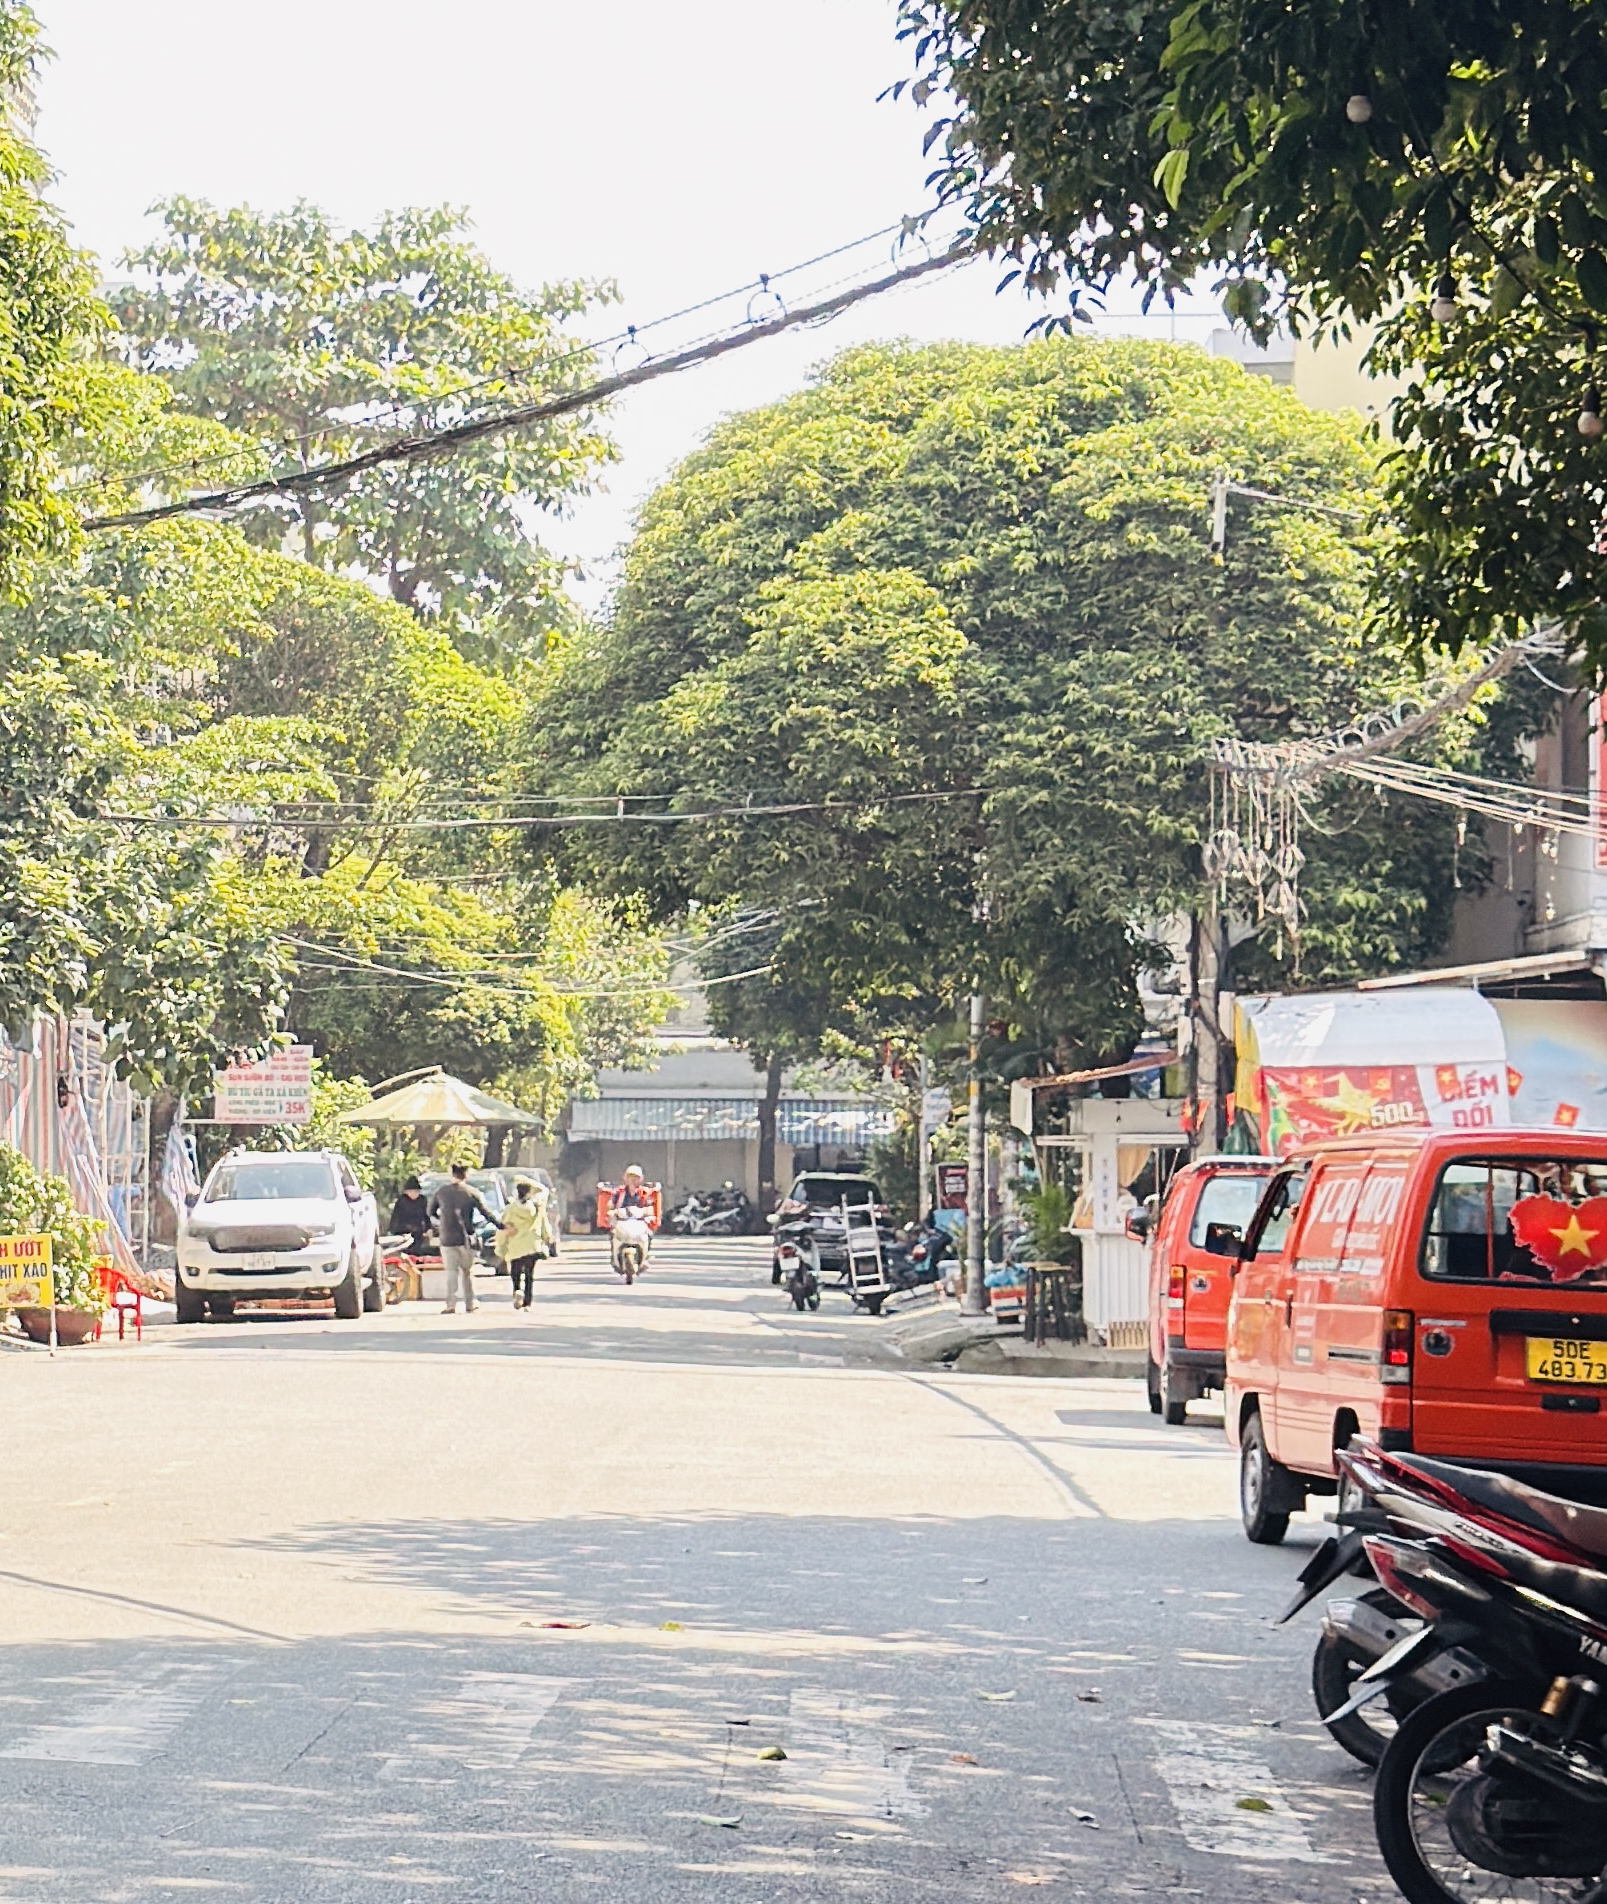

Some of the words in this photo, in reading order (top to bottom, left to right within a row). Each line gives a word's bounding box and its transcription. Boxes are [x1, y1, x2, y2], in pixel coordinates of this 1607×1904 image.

[1370, 1101, 1413, 1127] 500
[14, 1239, 44, 1256] ƯỚT
[1538, 1359, 1607, 1380] 483.73
